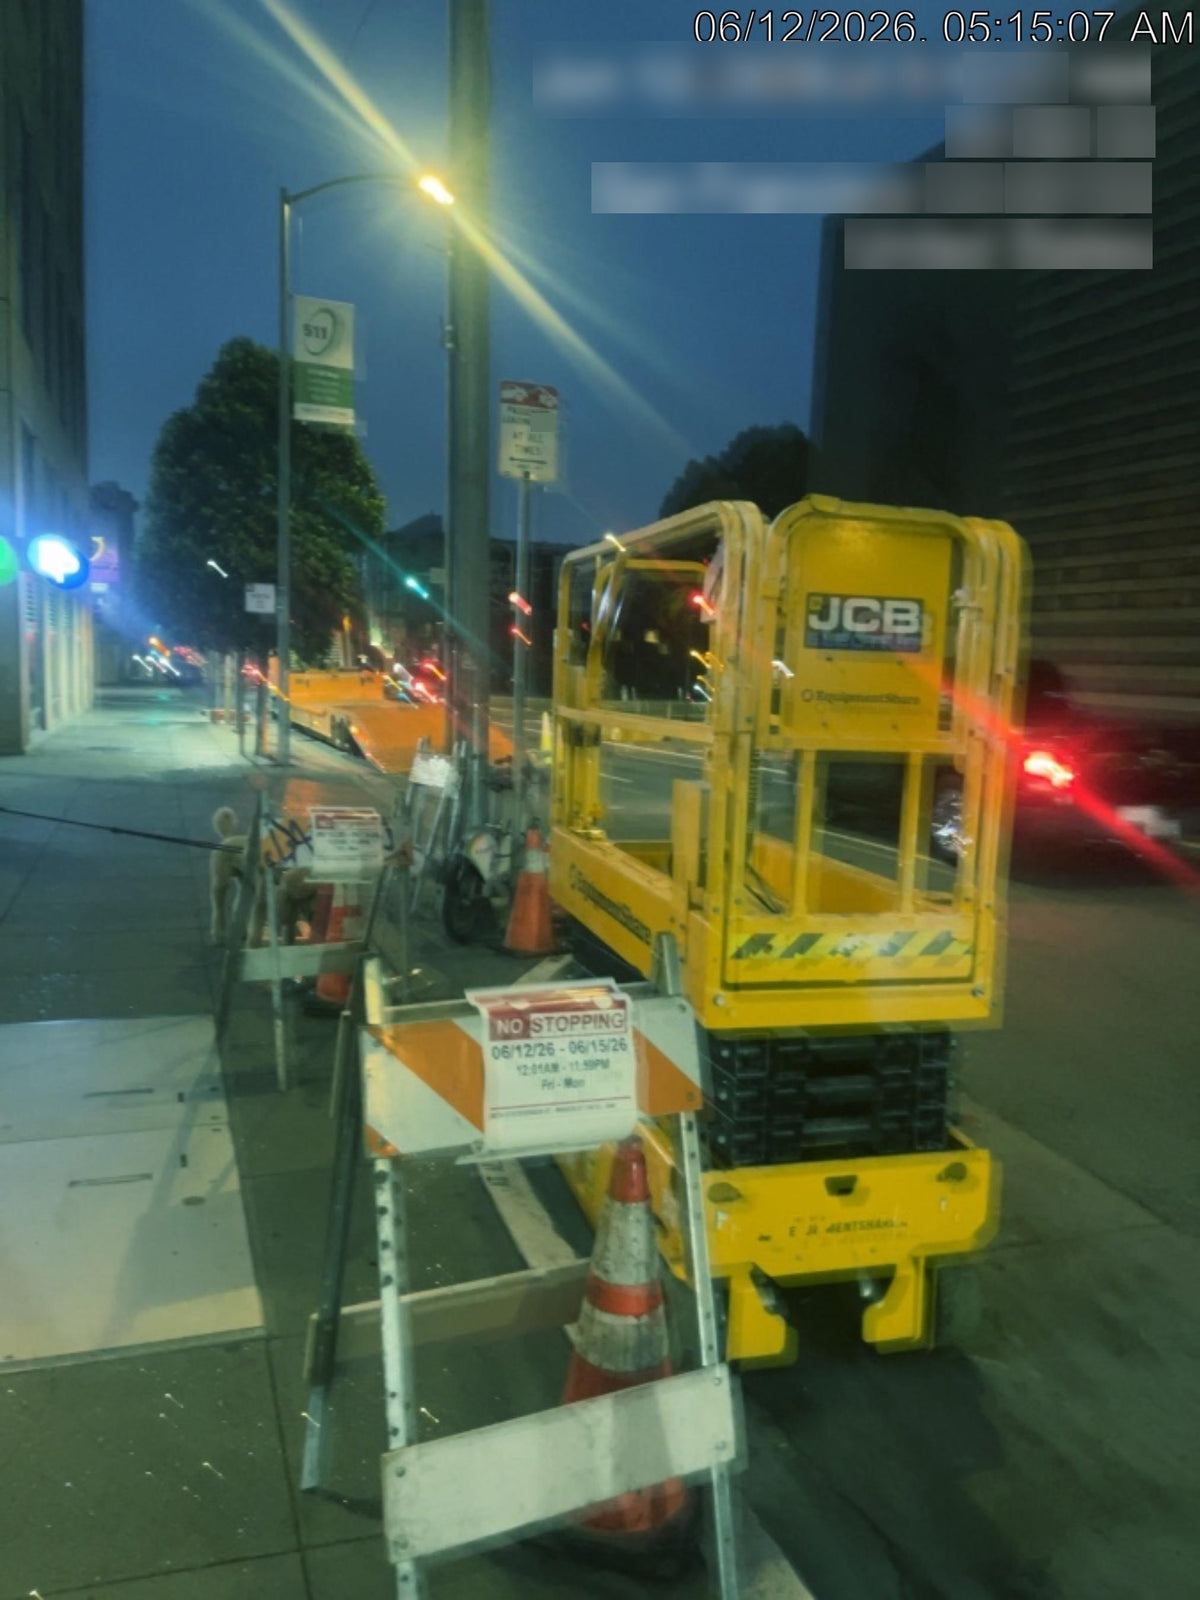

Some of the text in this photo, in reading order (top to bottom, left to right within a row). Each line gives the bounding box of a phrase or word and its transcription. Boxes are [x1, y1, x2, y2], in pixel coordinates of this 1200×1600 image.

[808, 597, 920, 633] JCB
[496, 1013, 625, 1035] NO STOPPING
[491, 1042, 556, 1061] 06/12/26
[568, 1037, 628, 1055] 06/15/26
